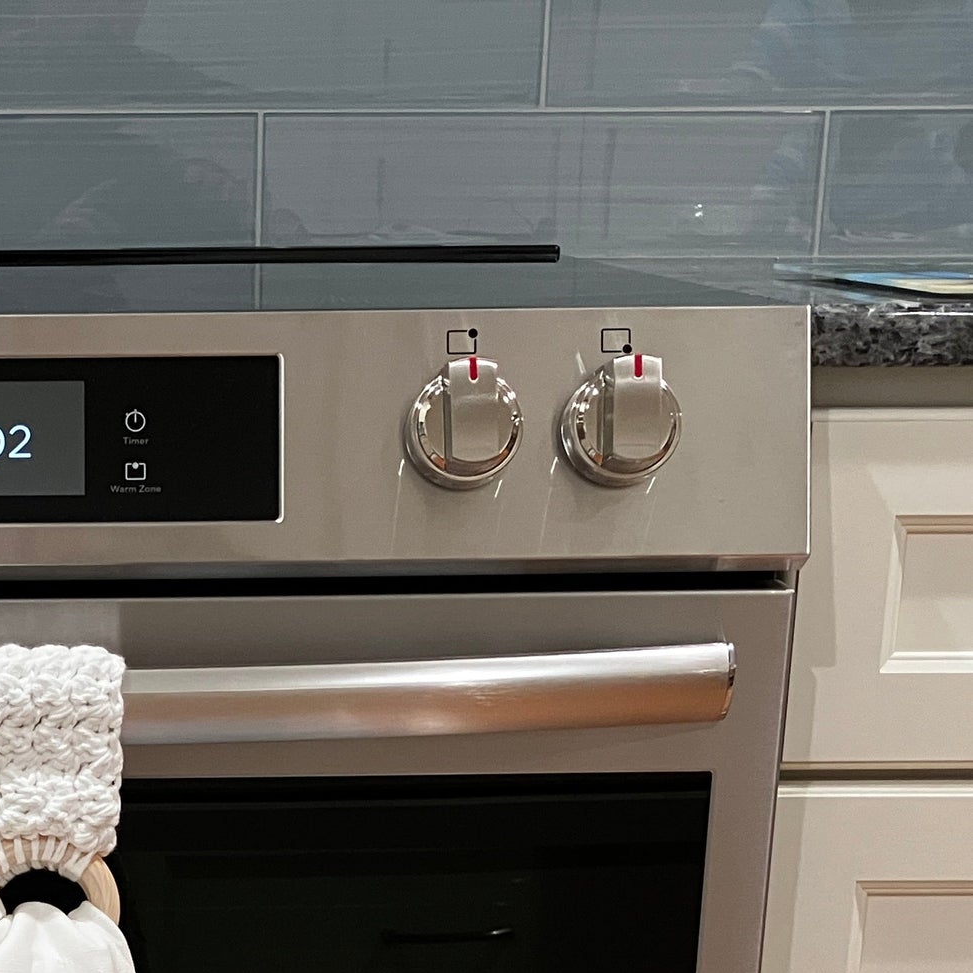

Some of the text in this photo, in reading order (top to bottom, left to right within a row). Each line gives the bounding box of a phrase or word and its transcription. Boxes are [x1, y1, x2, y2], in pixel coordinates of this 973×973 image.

[123, 437, 149, 445] Timer
[110, 485, 162, 493] Warm Zone
